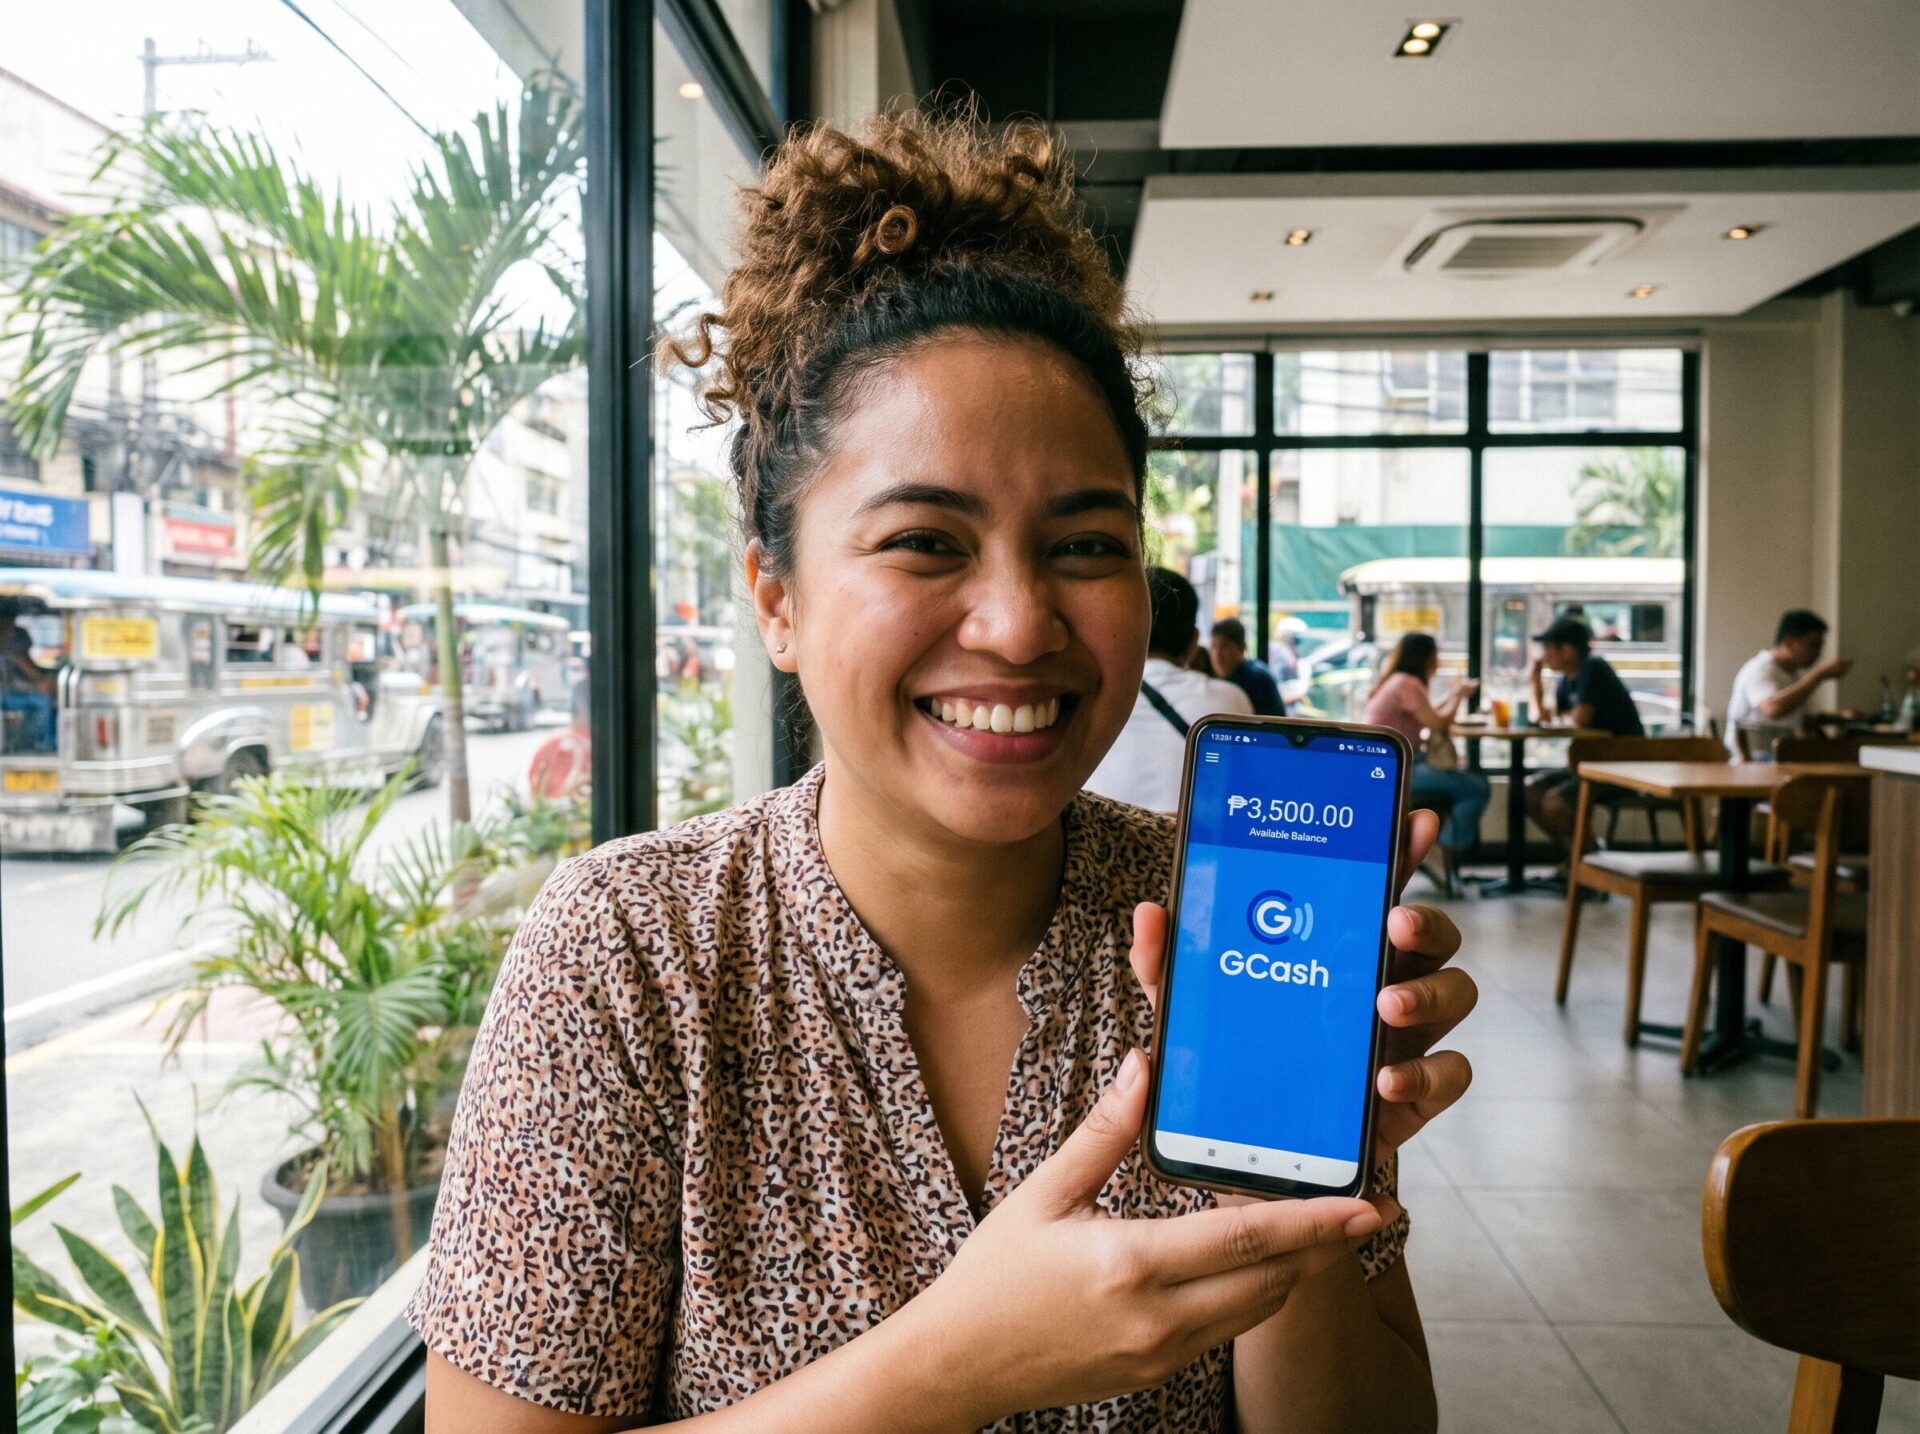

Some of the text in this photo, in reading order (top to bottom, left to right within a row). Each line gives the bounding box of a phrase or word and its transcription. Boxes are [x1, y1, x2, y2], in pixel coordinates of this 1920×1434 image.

[1227, 795, 1354, 828] ₱3,500.00
[1249, 827, 1328, 844] Available Balance
[1219, 950, 1329, 988] GCash
